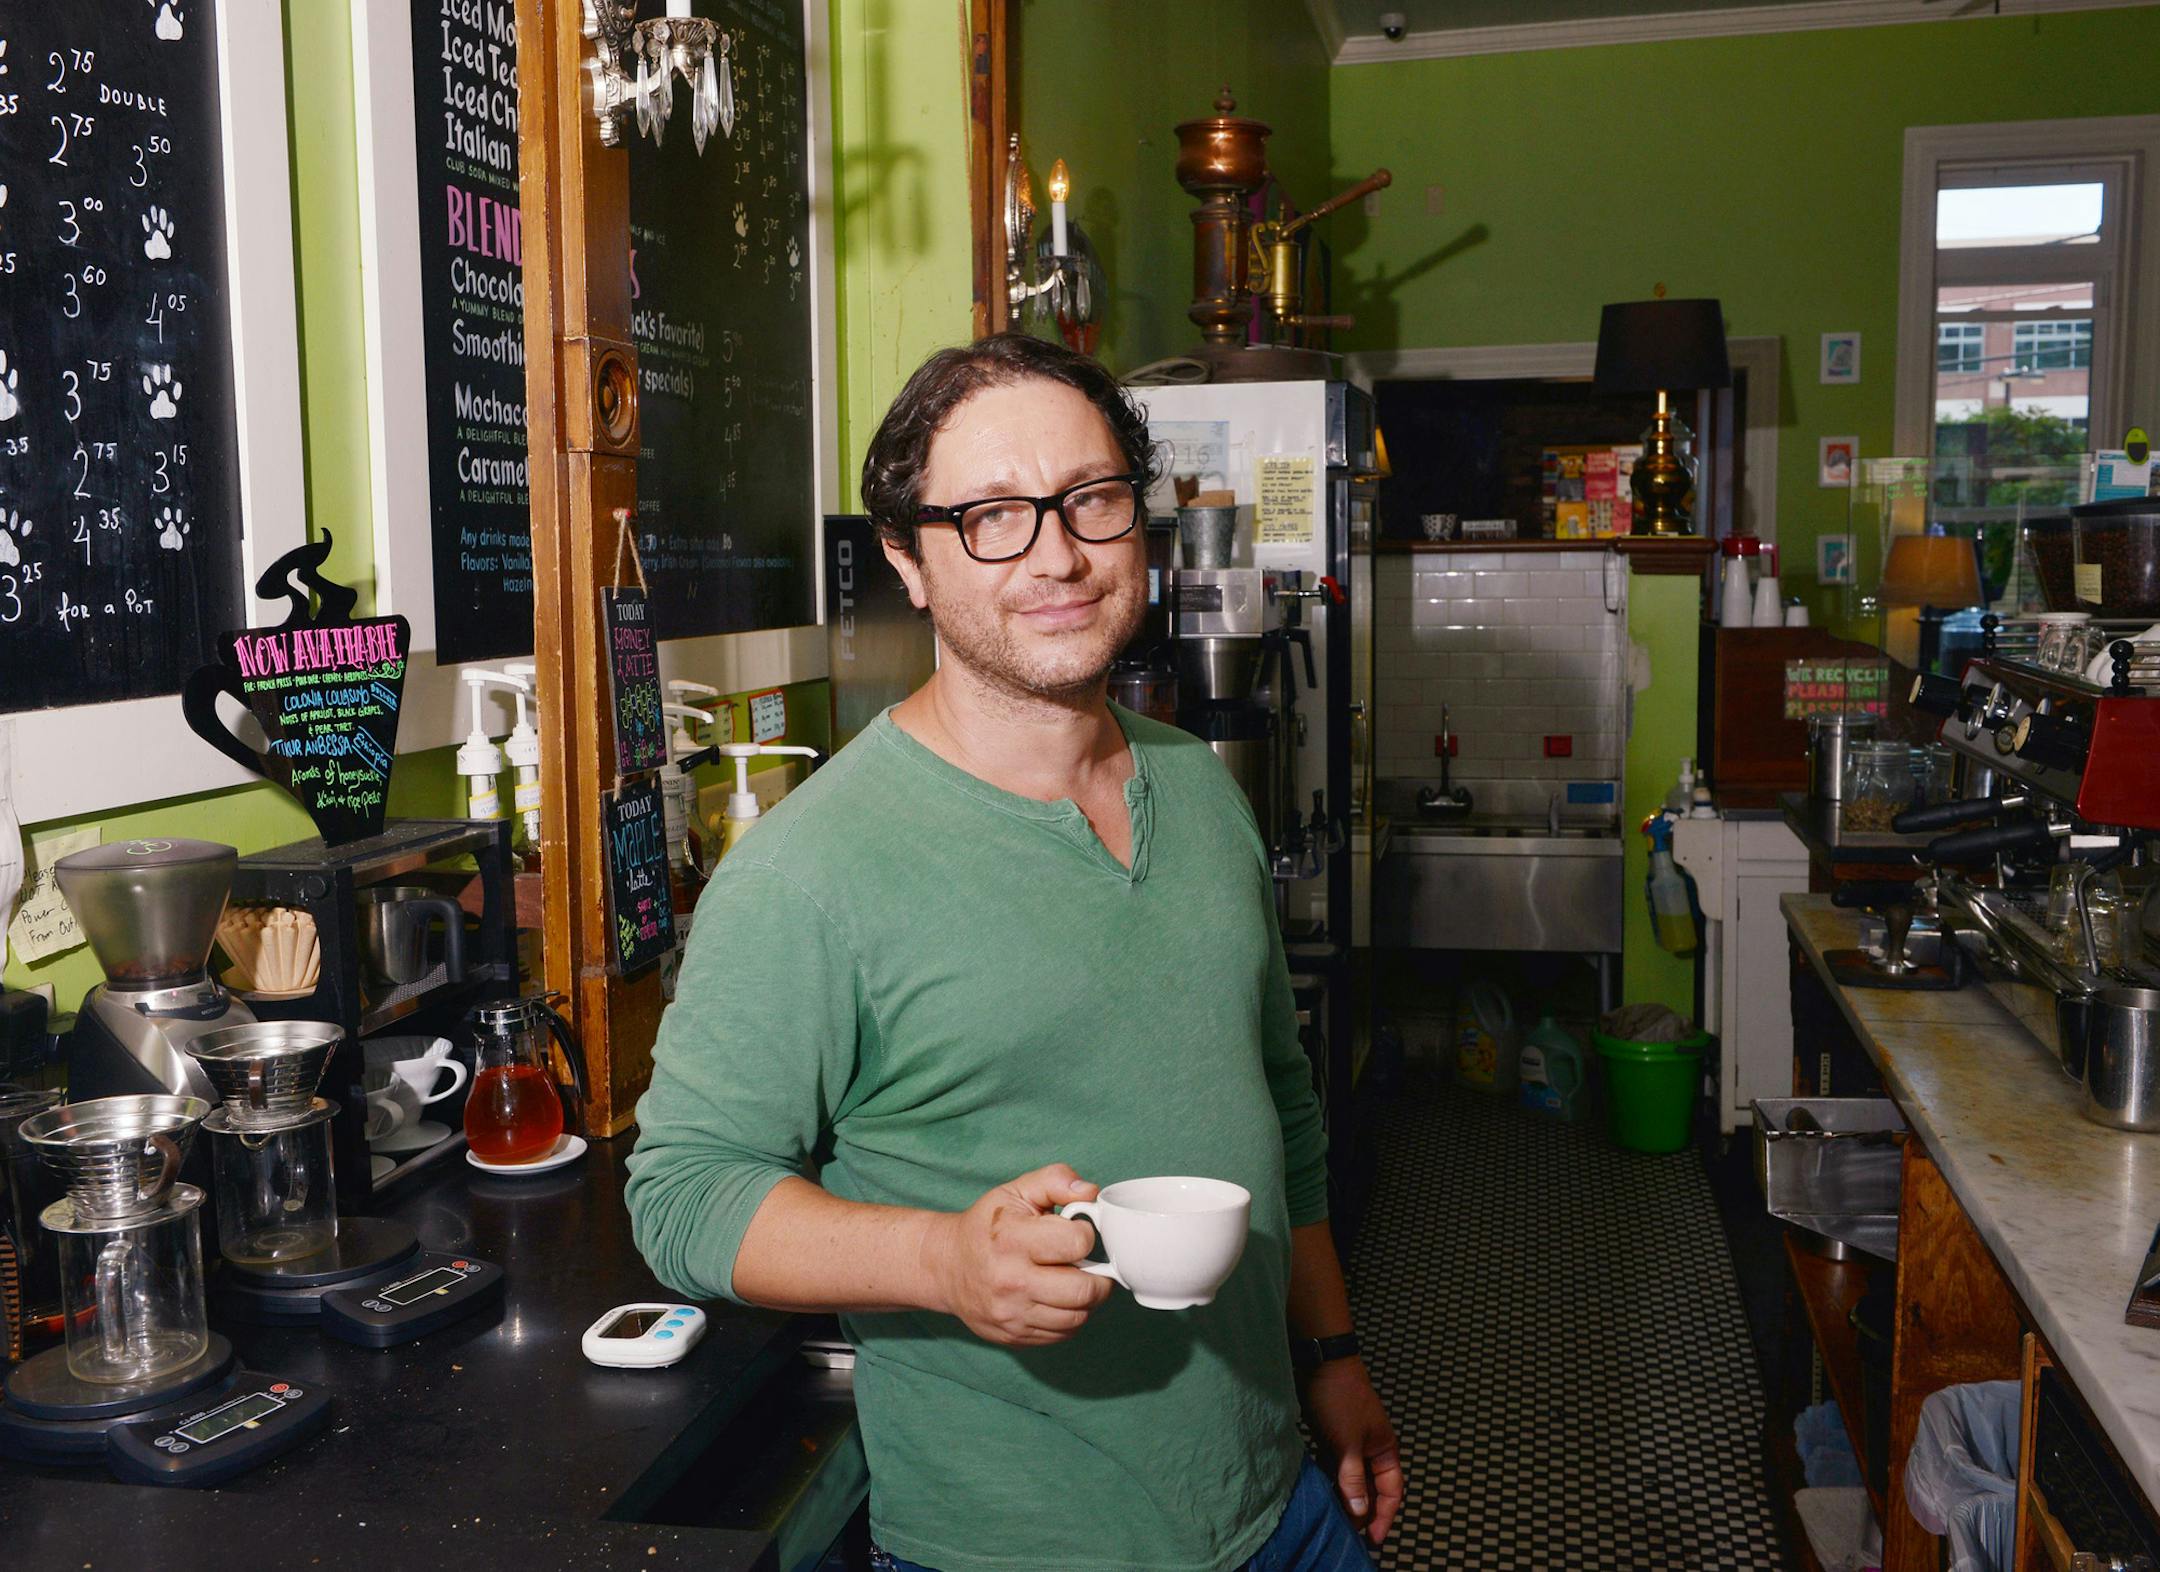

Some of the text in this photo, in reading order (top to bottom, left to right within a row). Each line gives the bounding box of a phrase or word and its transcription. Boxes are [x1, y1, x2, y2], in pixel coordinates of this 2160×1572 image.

[441, 20, 485, 77] Iced
[100, 84, 166, 116] DOUBLE
[442, 66, 517, 133] Iced Ch
[444, 111, 512, 172] Italian
[446, 156, 466, 174] CLUB
[459, 300, 490, 317] YUMMY
[452, 318, 526, 367] Smoothi
[658, 312, 705, 353] Favorite)
[465, 427, 511, 445] DELIGHTFUL
[468, 490, 514, 505] DELIGHTFUL
[460, 526, 477, 549] Any
[479, 528, 507, 547] drinks
[460, 551, 499, 572] Flavors:
[104, 605, 115, 614] a
[615, 603, 646, 622] TODAY
[234, 623, 402, 677] NOW AVAILABLE
[616, 652, 656, 686] LATTE
[284, 689, 324, 712] COLONIA
[279, 711, 299, 727] NOTES
[301, 710, 309, 722] OF
[314, 723, 334, 736] PEAR
[617, 795, 652, 823] TODAY
[21, 908, 55, 925] Power
[28, 929, 54, 945] From
